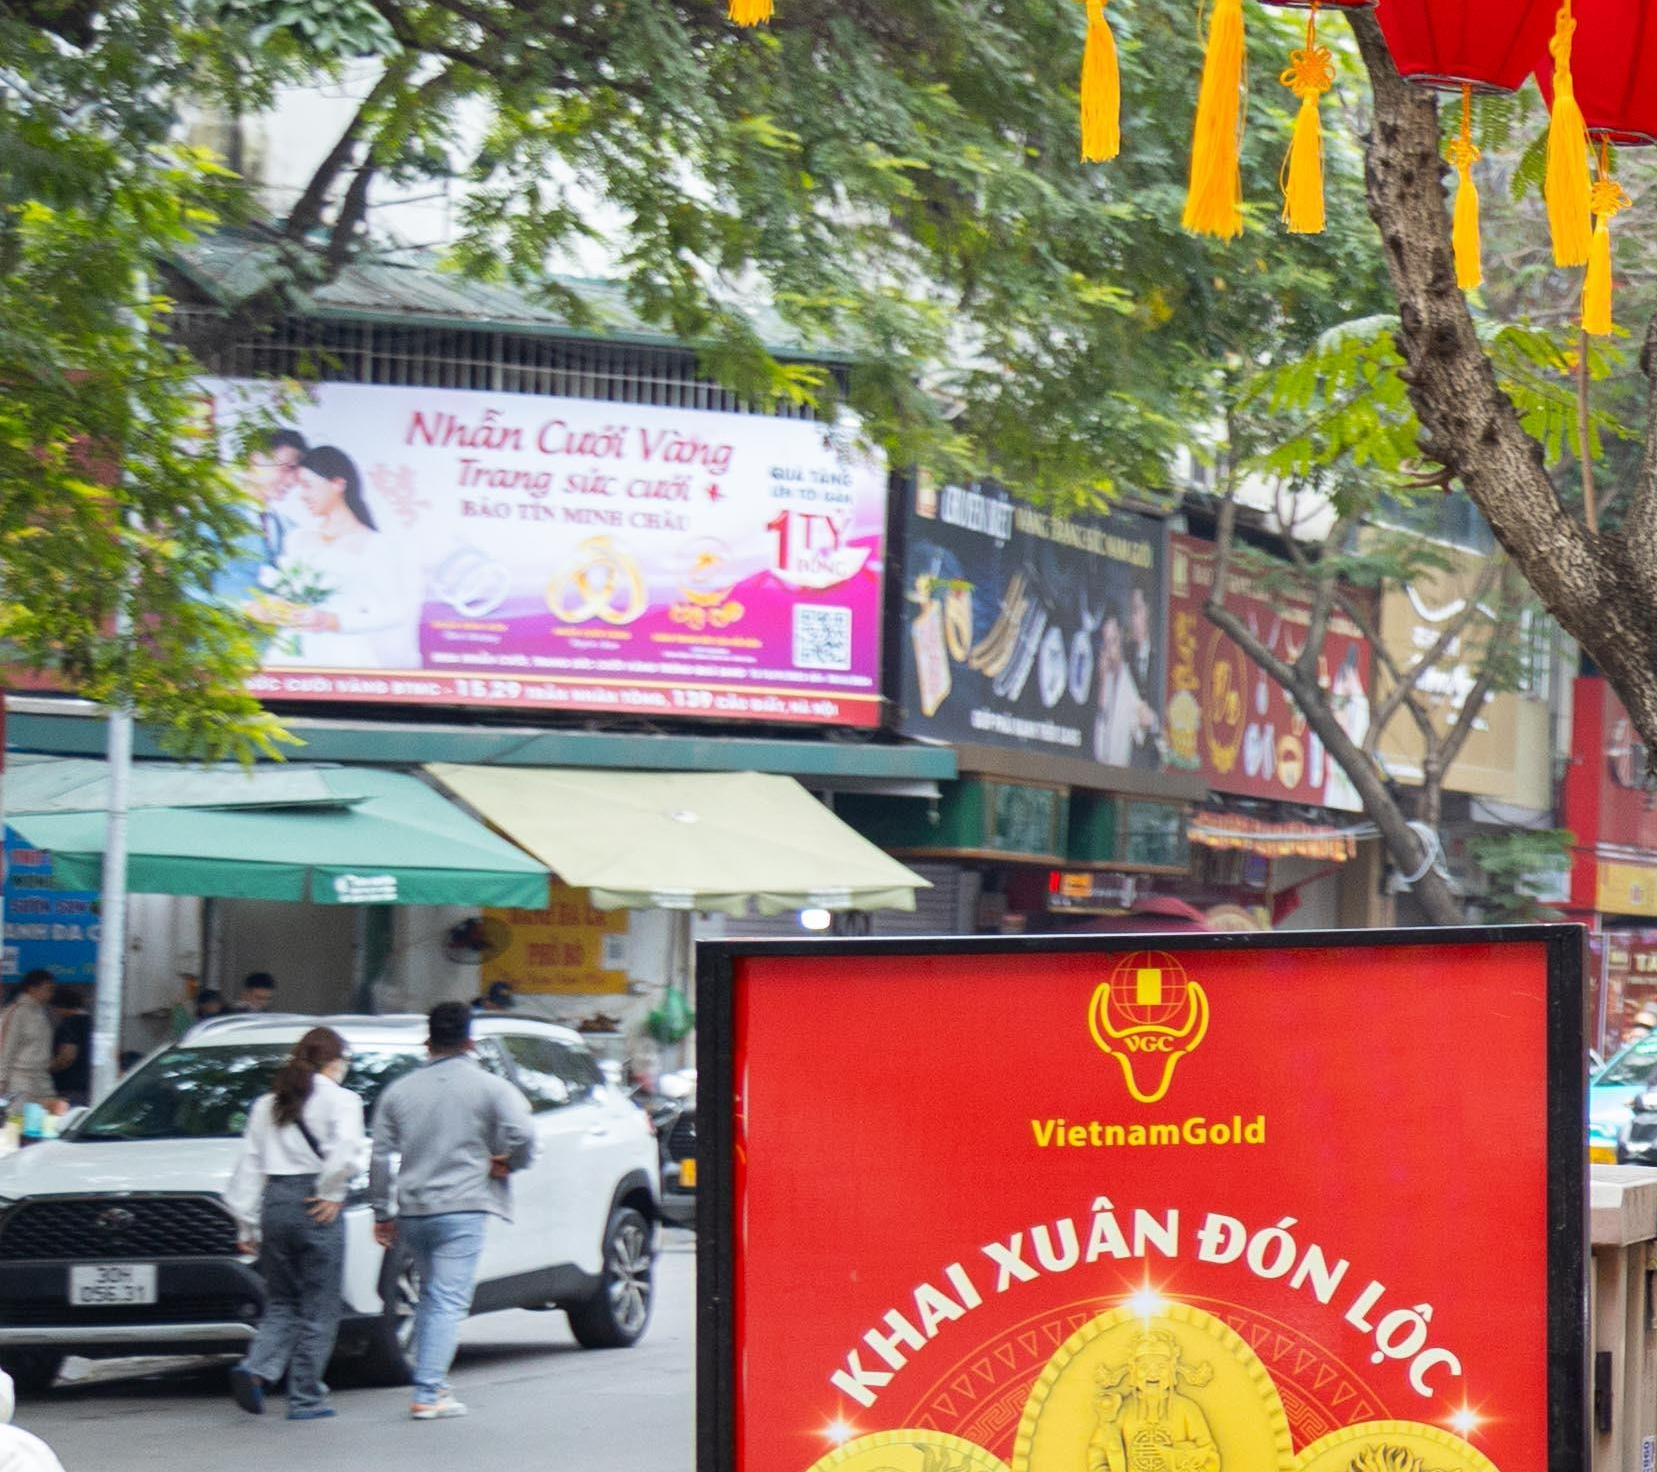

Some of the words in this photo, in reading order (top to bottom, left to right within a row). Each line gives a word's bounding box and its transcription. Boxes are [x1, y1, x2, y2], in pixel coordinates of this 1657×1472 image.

[405, 407, 522, 453] Nhẫn
[537, 419, 627, 463] Cưới
[637, 426, 735, 476] Vàng
[456, 457, 552, 499] Trang
[1123, 1033, 1176, 1055] VGC
[1030, 1113, 1267, 1150] VietnamGold
[828, 1262, 982, 1409] KHAI
[980, 1195, 1180, 1294] XUÂN
[1195, 1211, 1351, 1305] ĐÓN
[1343, 1279, 1464, 1399] LỘC
